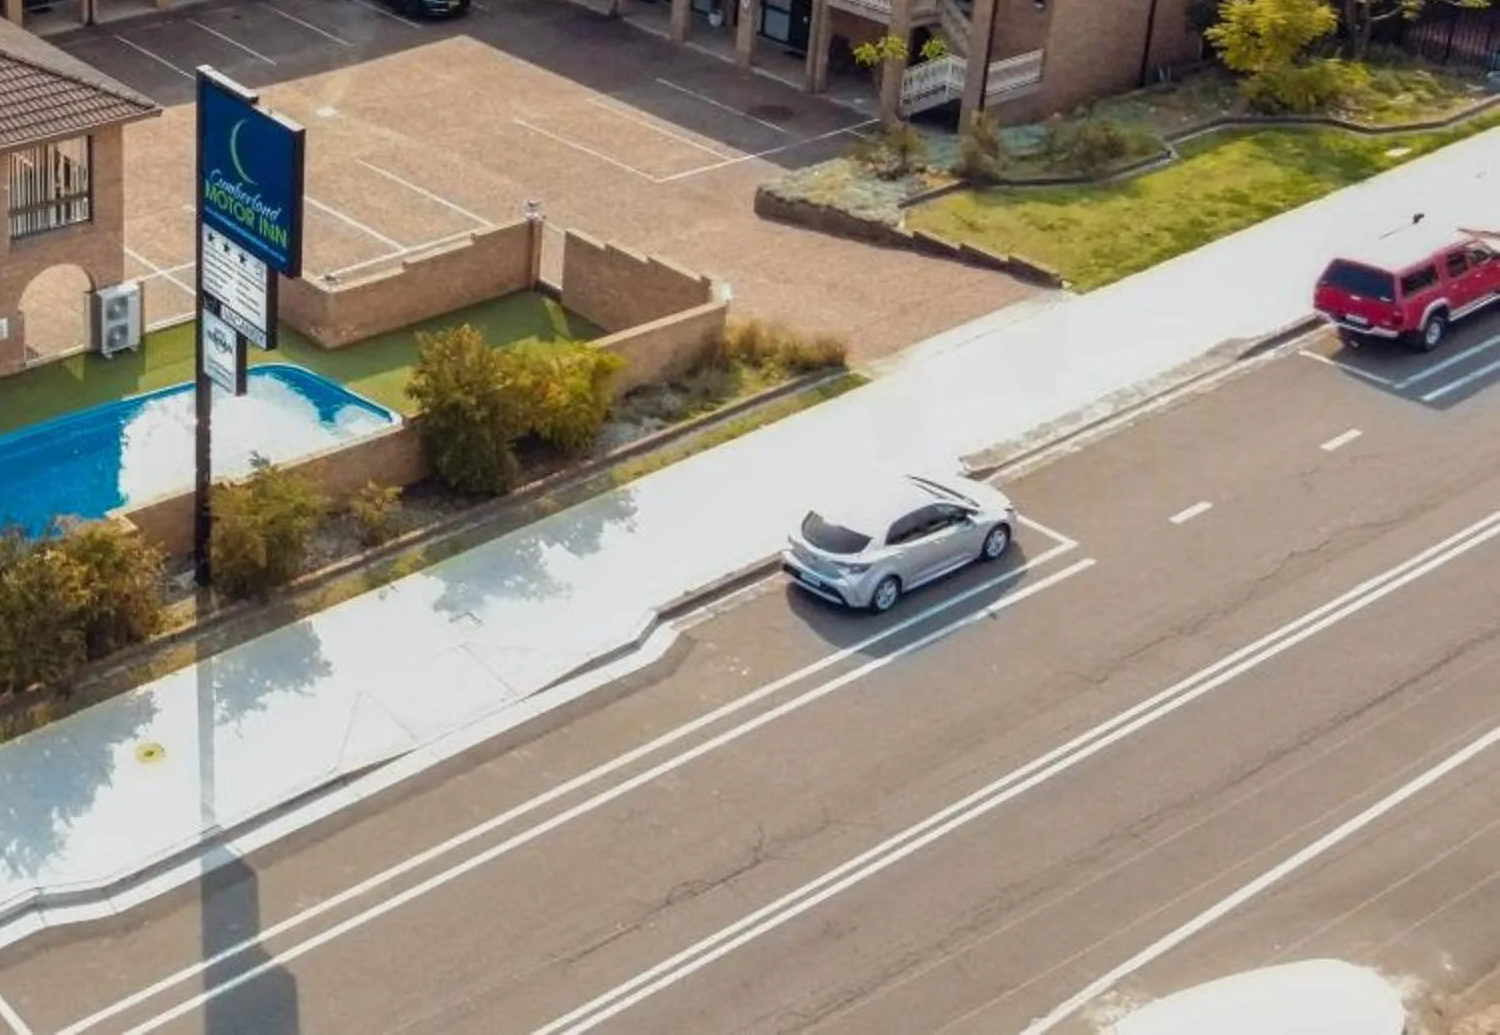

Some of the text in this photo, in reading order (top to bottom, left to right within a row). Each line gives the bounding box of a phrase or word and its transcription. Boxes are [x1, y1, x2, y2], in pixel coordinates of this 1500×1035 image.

[204, 178, 255, 230] MOTOR
[259, 213, 288, 249] INN
[211, 168, 282, 221] Cumberland
